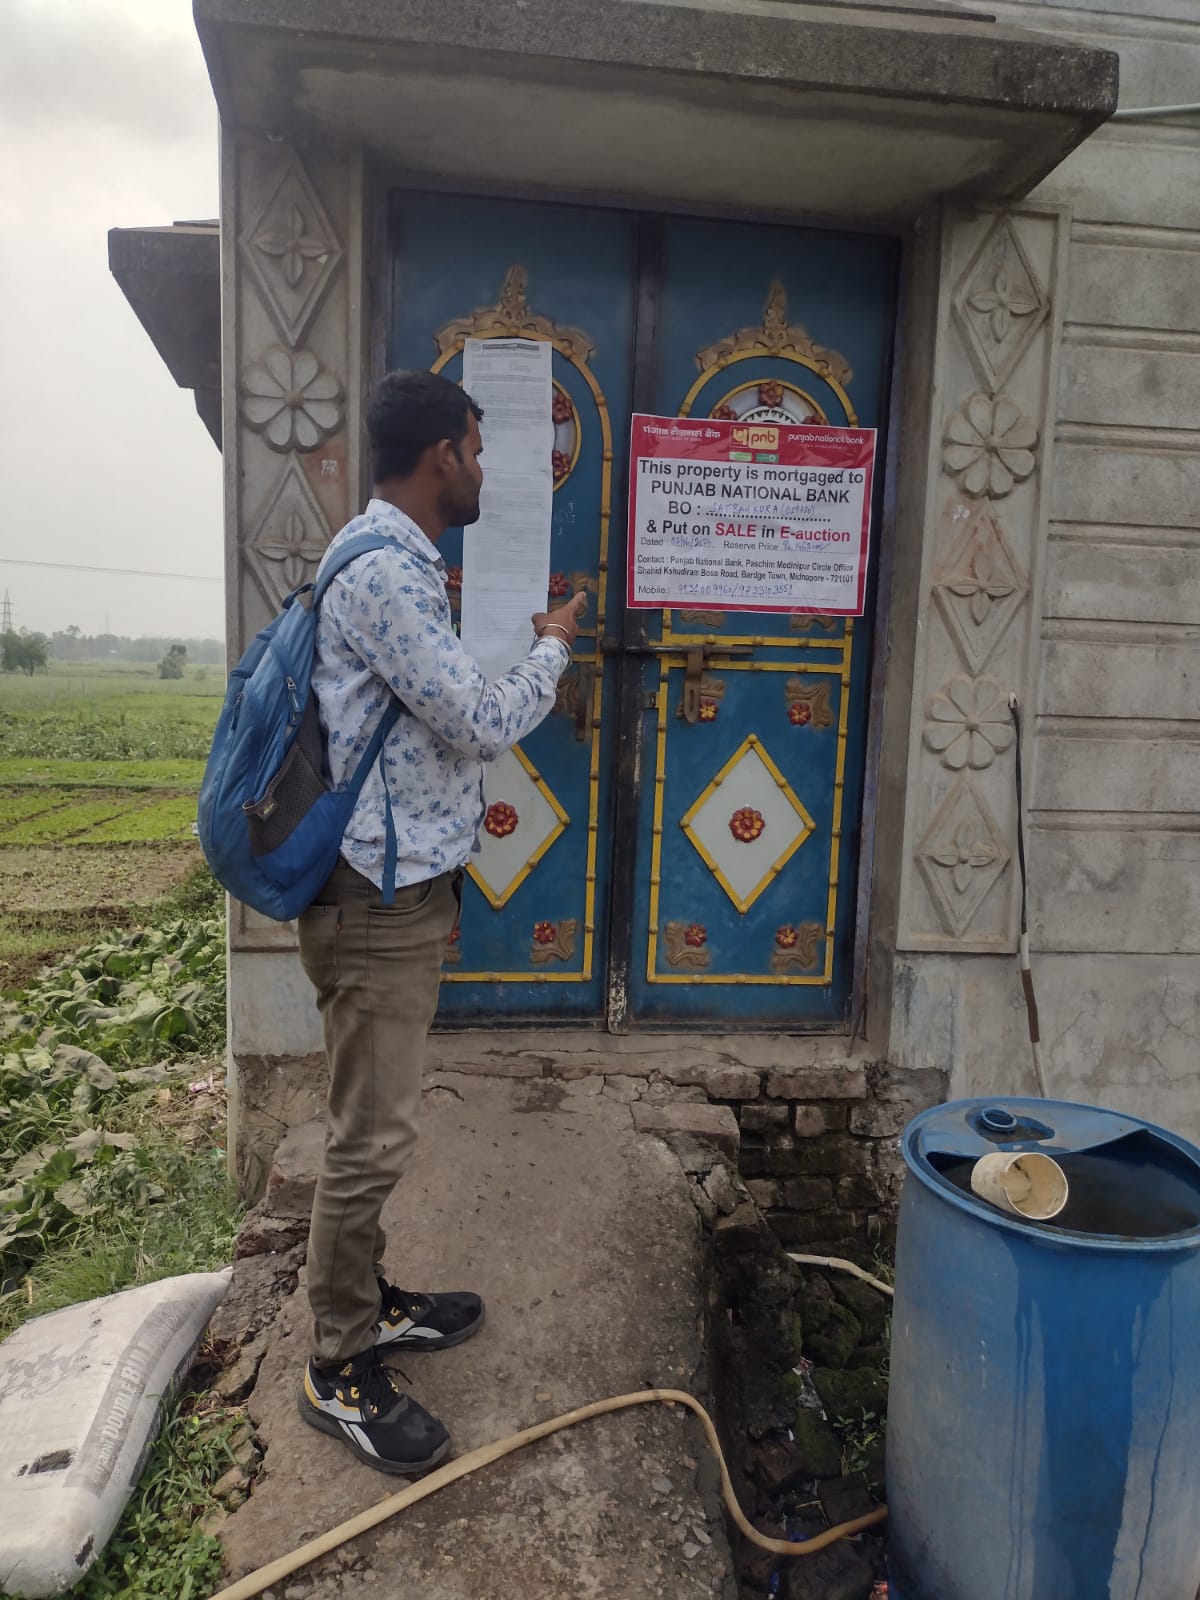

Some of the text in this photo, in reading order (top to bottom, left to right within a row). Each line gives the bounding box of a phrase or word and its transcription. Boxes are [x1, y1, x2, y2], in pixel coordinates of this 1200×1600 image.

[750, 430, 776, 446] pnb
[639, 459, 864, 485] This property is mortgaged to
[651, 480, 850, 503] PUNJAB NATIONAL BANK
[668, 500, 692, 515] BO
[646, 520, 851, 542] & Put on SALE in E-auction
[640, 537, 664, 546] Dated
[723, 541, 779, 551] Reserve Price
[670, 556, 694, 566] Punjab
[695, 557, 723, 566] National
[725, 558, 743, 568] Bank,
[745, 559, 775, 569] Paschim
[776, 561, 810, 571] Medinipur
[811, 562, 832, 571] Circle
[833, 563, 854, 572] Office
[637, 566, 662, 575] Shahid
[701, 568, 718, 577] Bose
[720, 569, 740, 578] Road,
[741, 571, 766, 581] Bardge
[768, 572, 788, 581] Town,
[789, 572, 824, 583] Midnapore
